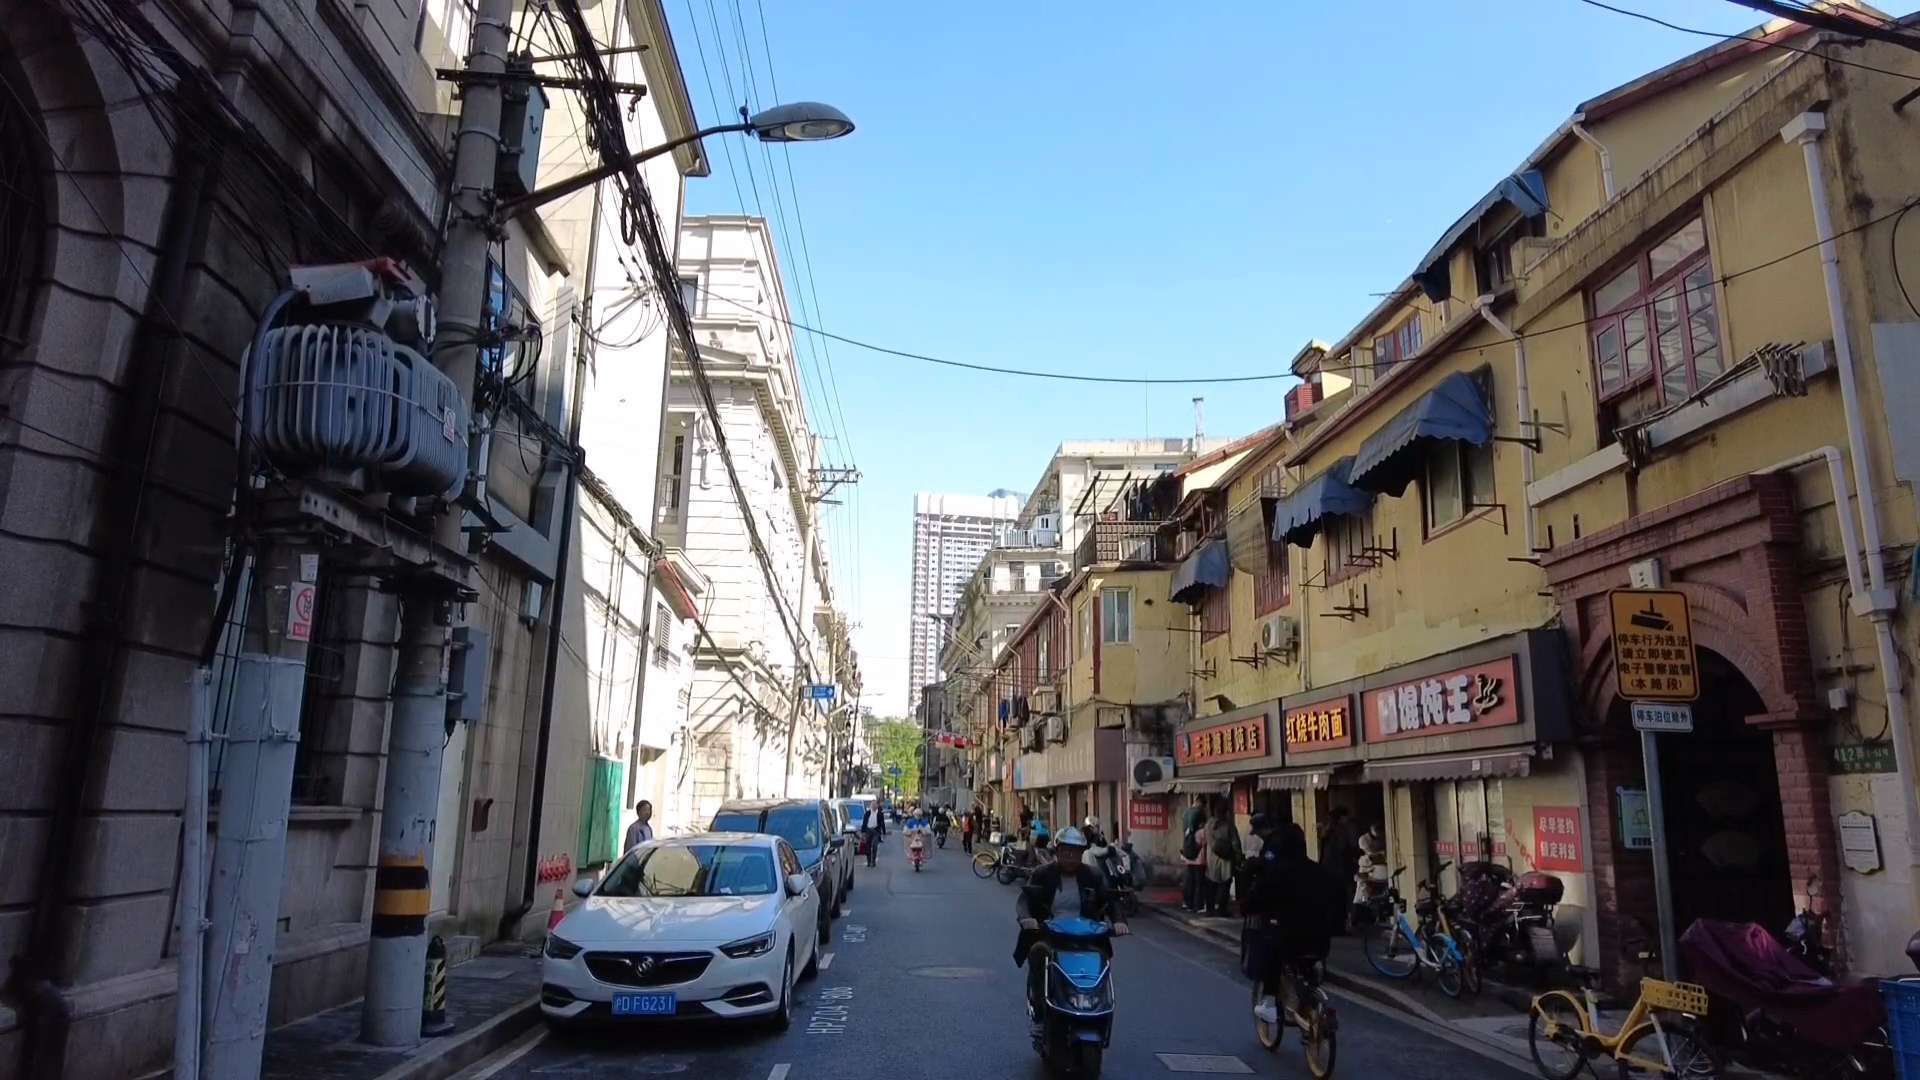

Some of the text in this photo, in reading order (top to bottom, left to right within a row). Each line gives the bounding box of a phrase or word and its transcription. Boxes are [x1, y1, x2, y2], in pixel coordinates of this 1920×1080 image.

[1618, 633, 1688, 647] 停车行为违法
[1622, 648, 1685, 661] 请立即驶离
[1378, 674, 1471, 735] 馄饨王
[1286, 708, 1343, 744] 红烧牛肉面
